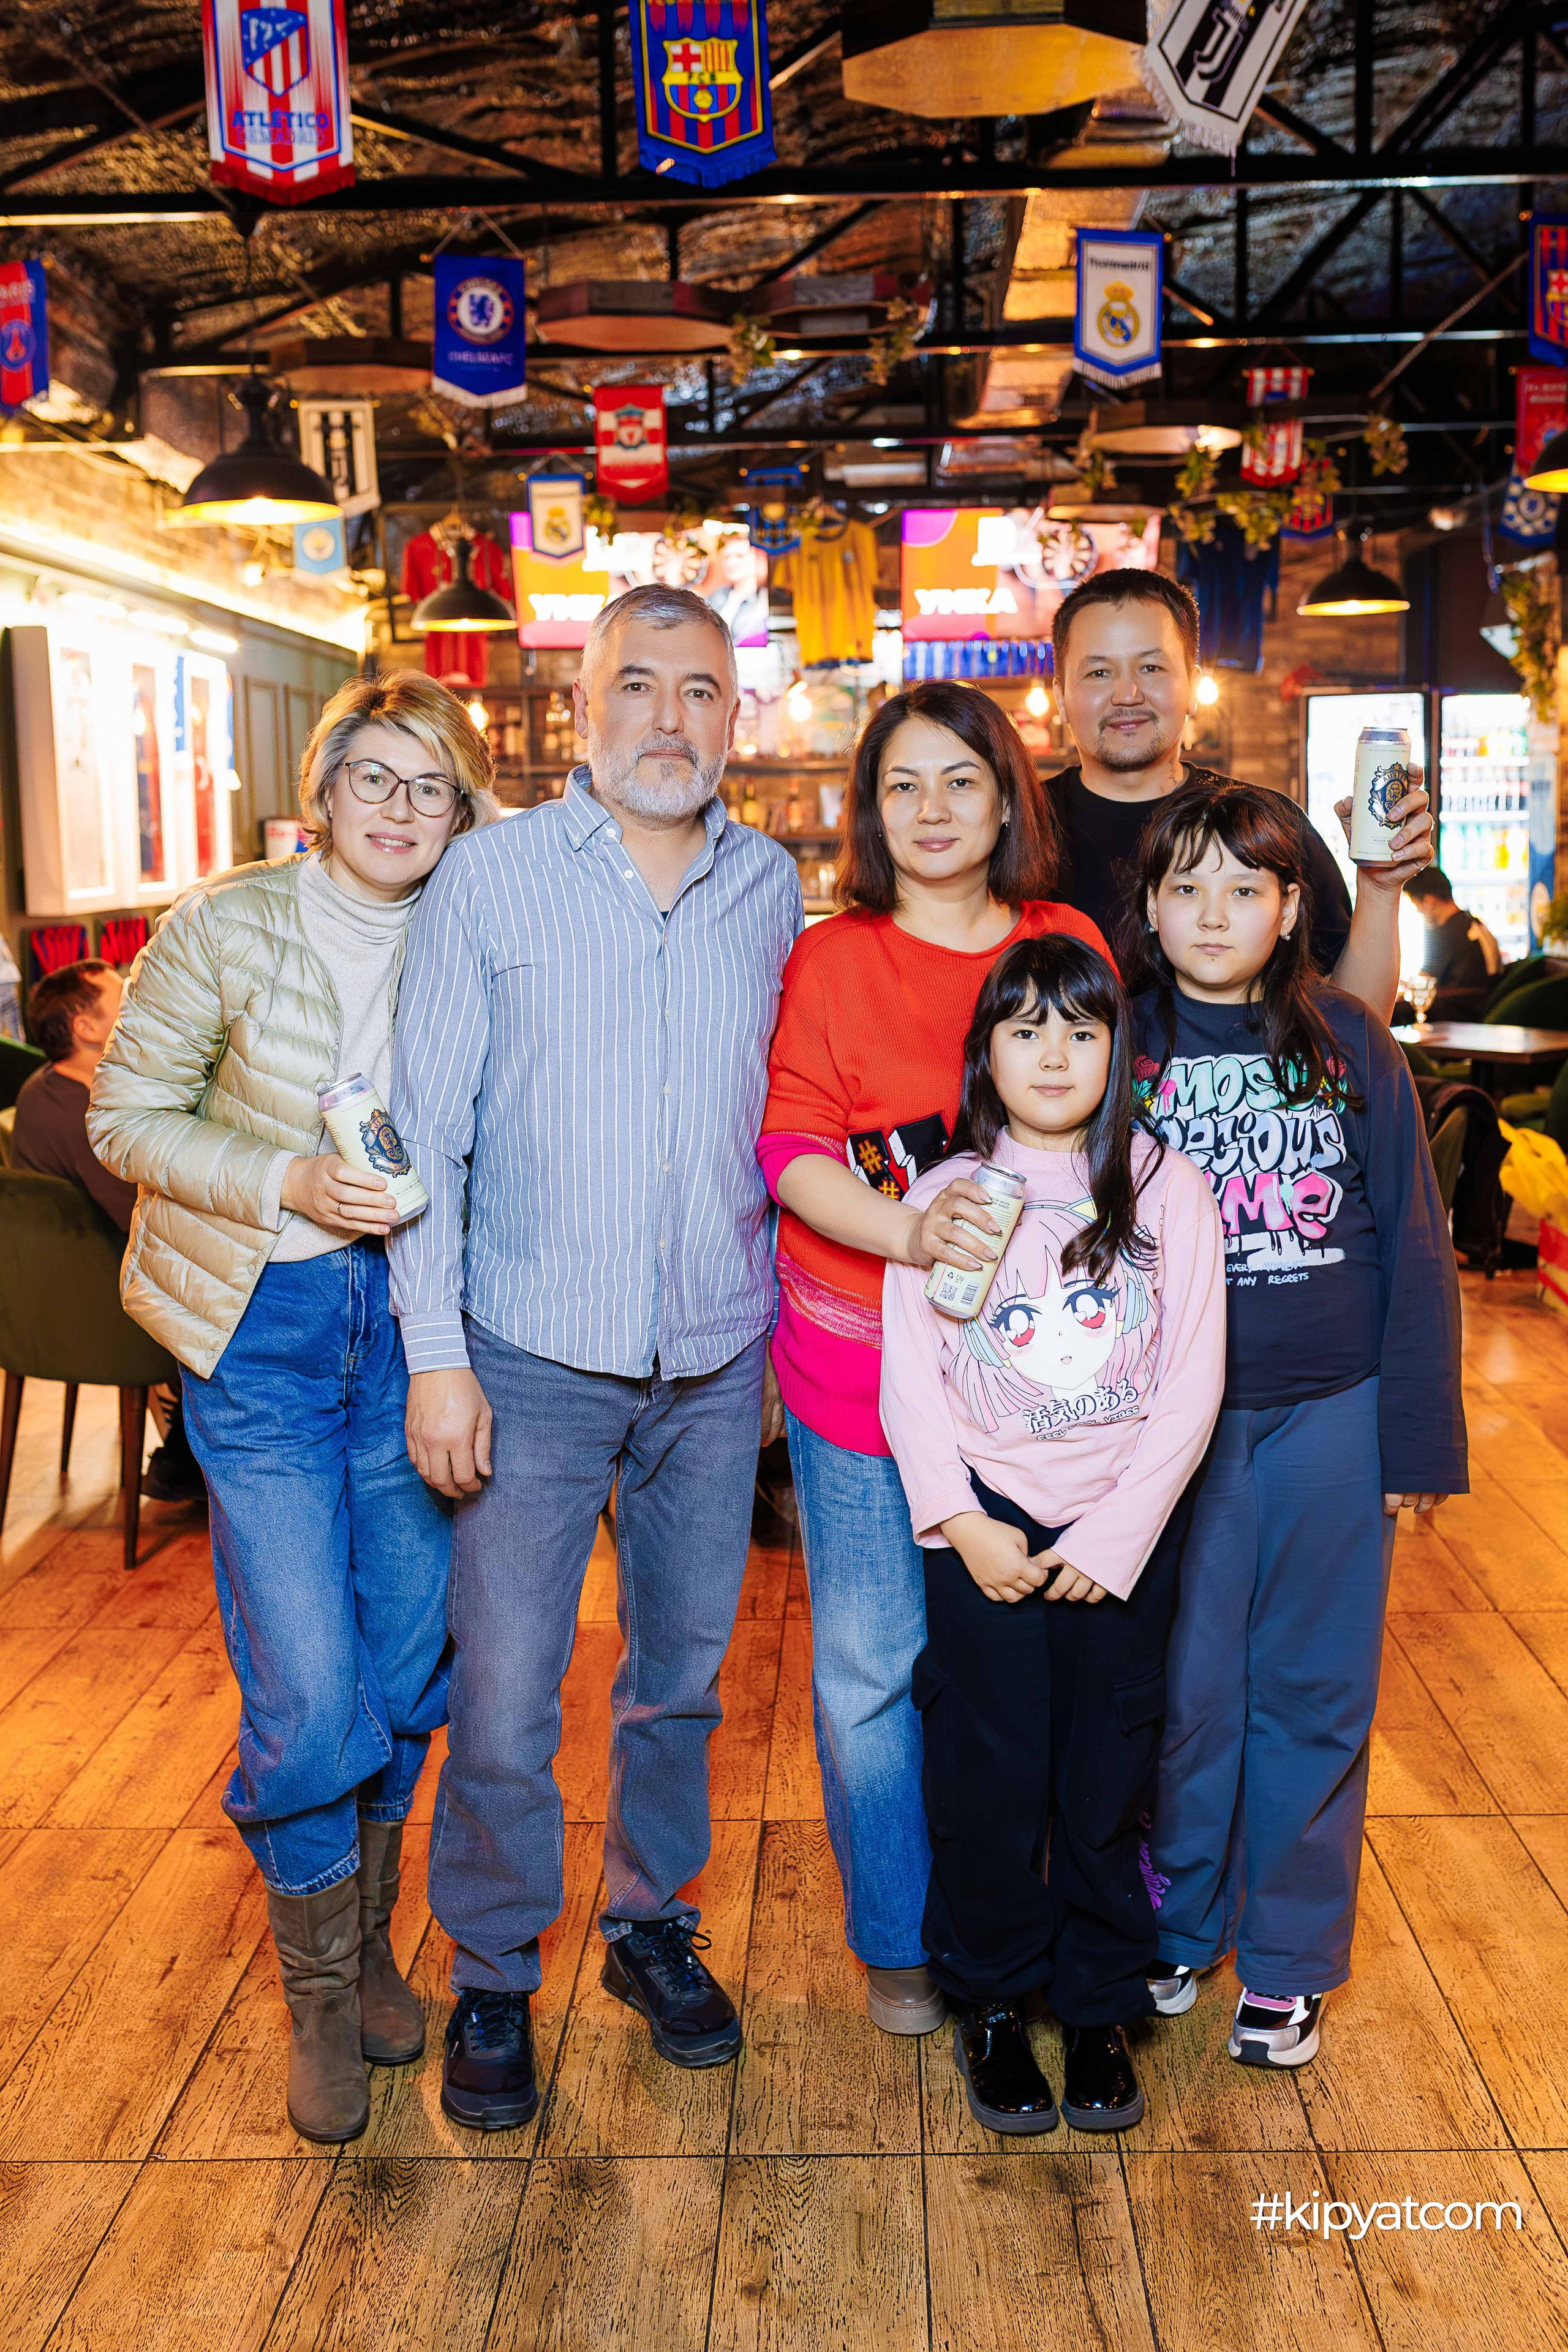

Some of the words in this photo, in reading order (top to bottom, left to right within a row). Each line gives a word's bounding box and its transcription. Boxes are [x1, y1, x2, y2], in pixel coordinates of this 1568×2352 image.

[1226, 1263, 1252, 1273] EVERY
[1237, 1276, 1257, 1286] ANY
[1267, 1272, 1310, 1284] REGRETS
[1022, 1378, 1139, 1434] 活気のある
[1036, 1428, 1067, 1441] FEEL
[1103, 1405, 1140, 1424] VIBES
